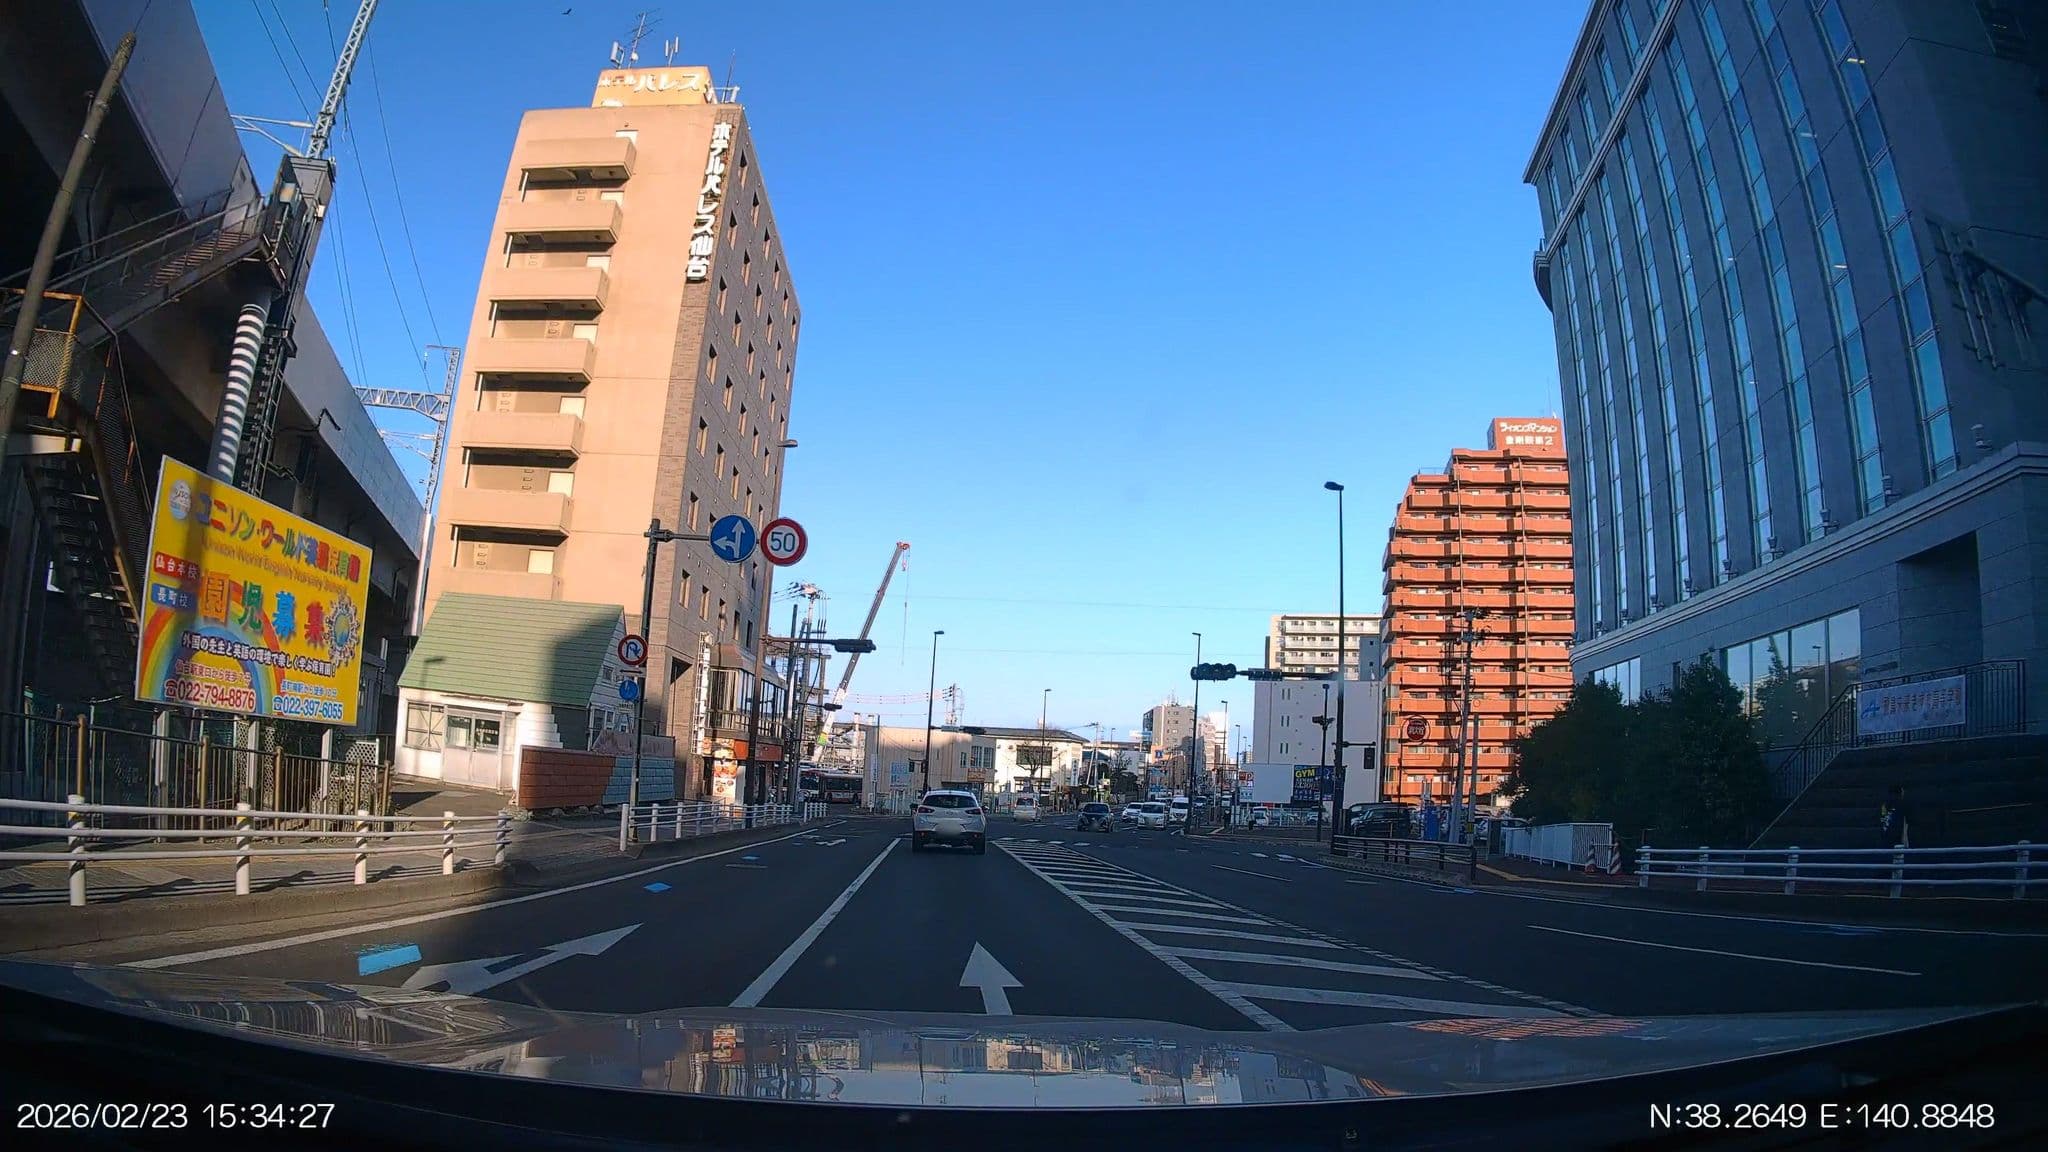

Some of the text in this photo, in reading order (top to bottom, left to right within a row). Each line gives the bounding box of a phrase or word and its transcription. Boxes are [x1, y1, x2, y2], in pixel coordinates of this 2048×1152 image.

[686, 122, 732, 281] ホテルパレス仙台
[770, 532, 796, 553] 50
[155, 554, 199, 580] 仙台本校
[156, 586, 190, 609] 長町校
[200, 570, 327, 646] 園児募集
[177, 681, 256, 711] 022-794-8876
[283, 697, 343, 720] 022-397-6055
[1295, 769, 1315, 778] GYM
